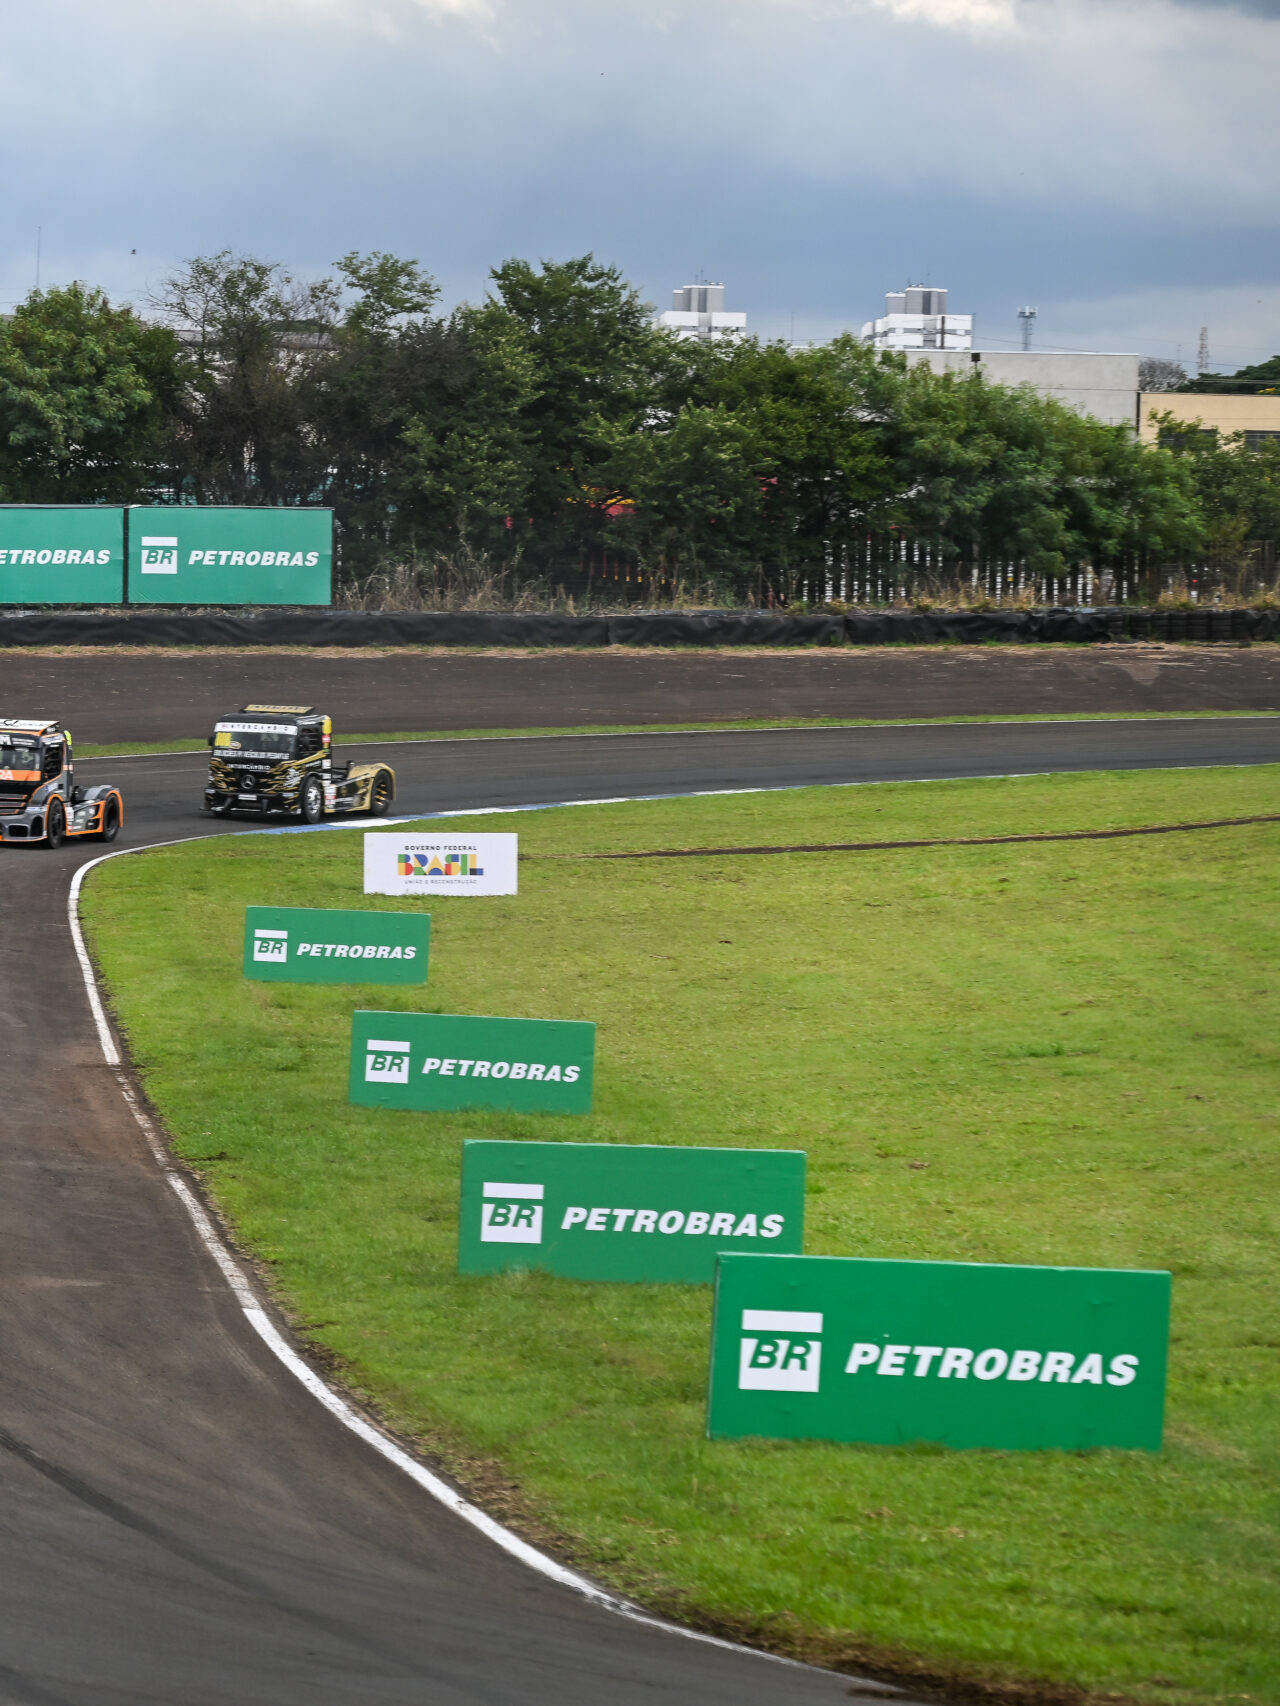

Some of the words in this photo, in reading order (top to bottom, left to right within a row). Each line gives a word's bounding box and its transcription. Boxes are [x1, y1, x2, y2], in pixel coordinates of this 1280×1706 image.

[188, 550, 319, 566] PETROBRAS
[397, 853, 484, 876] BRASIL
[257, 941, 285, 955] BR
[296, 943, 417, 960] PETROBRAS
[369, 1056, 405, 1073] BR
[421, 1058, 581, 1083] PETROBRAS
[487, 1205, 536, 1230] BR
[561, 1207, 785, 1239] PETROBRAS
[750, 1340, 814, 1373] BR
[845, 1344, 1140, 1386] PETROBRAS
